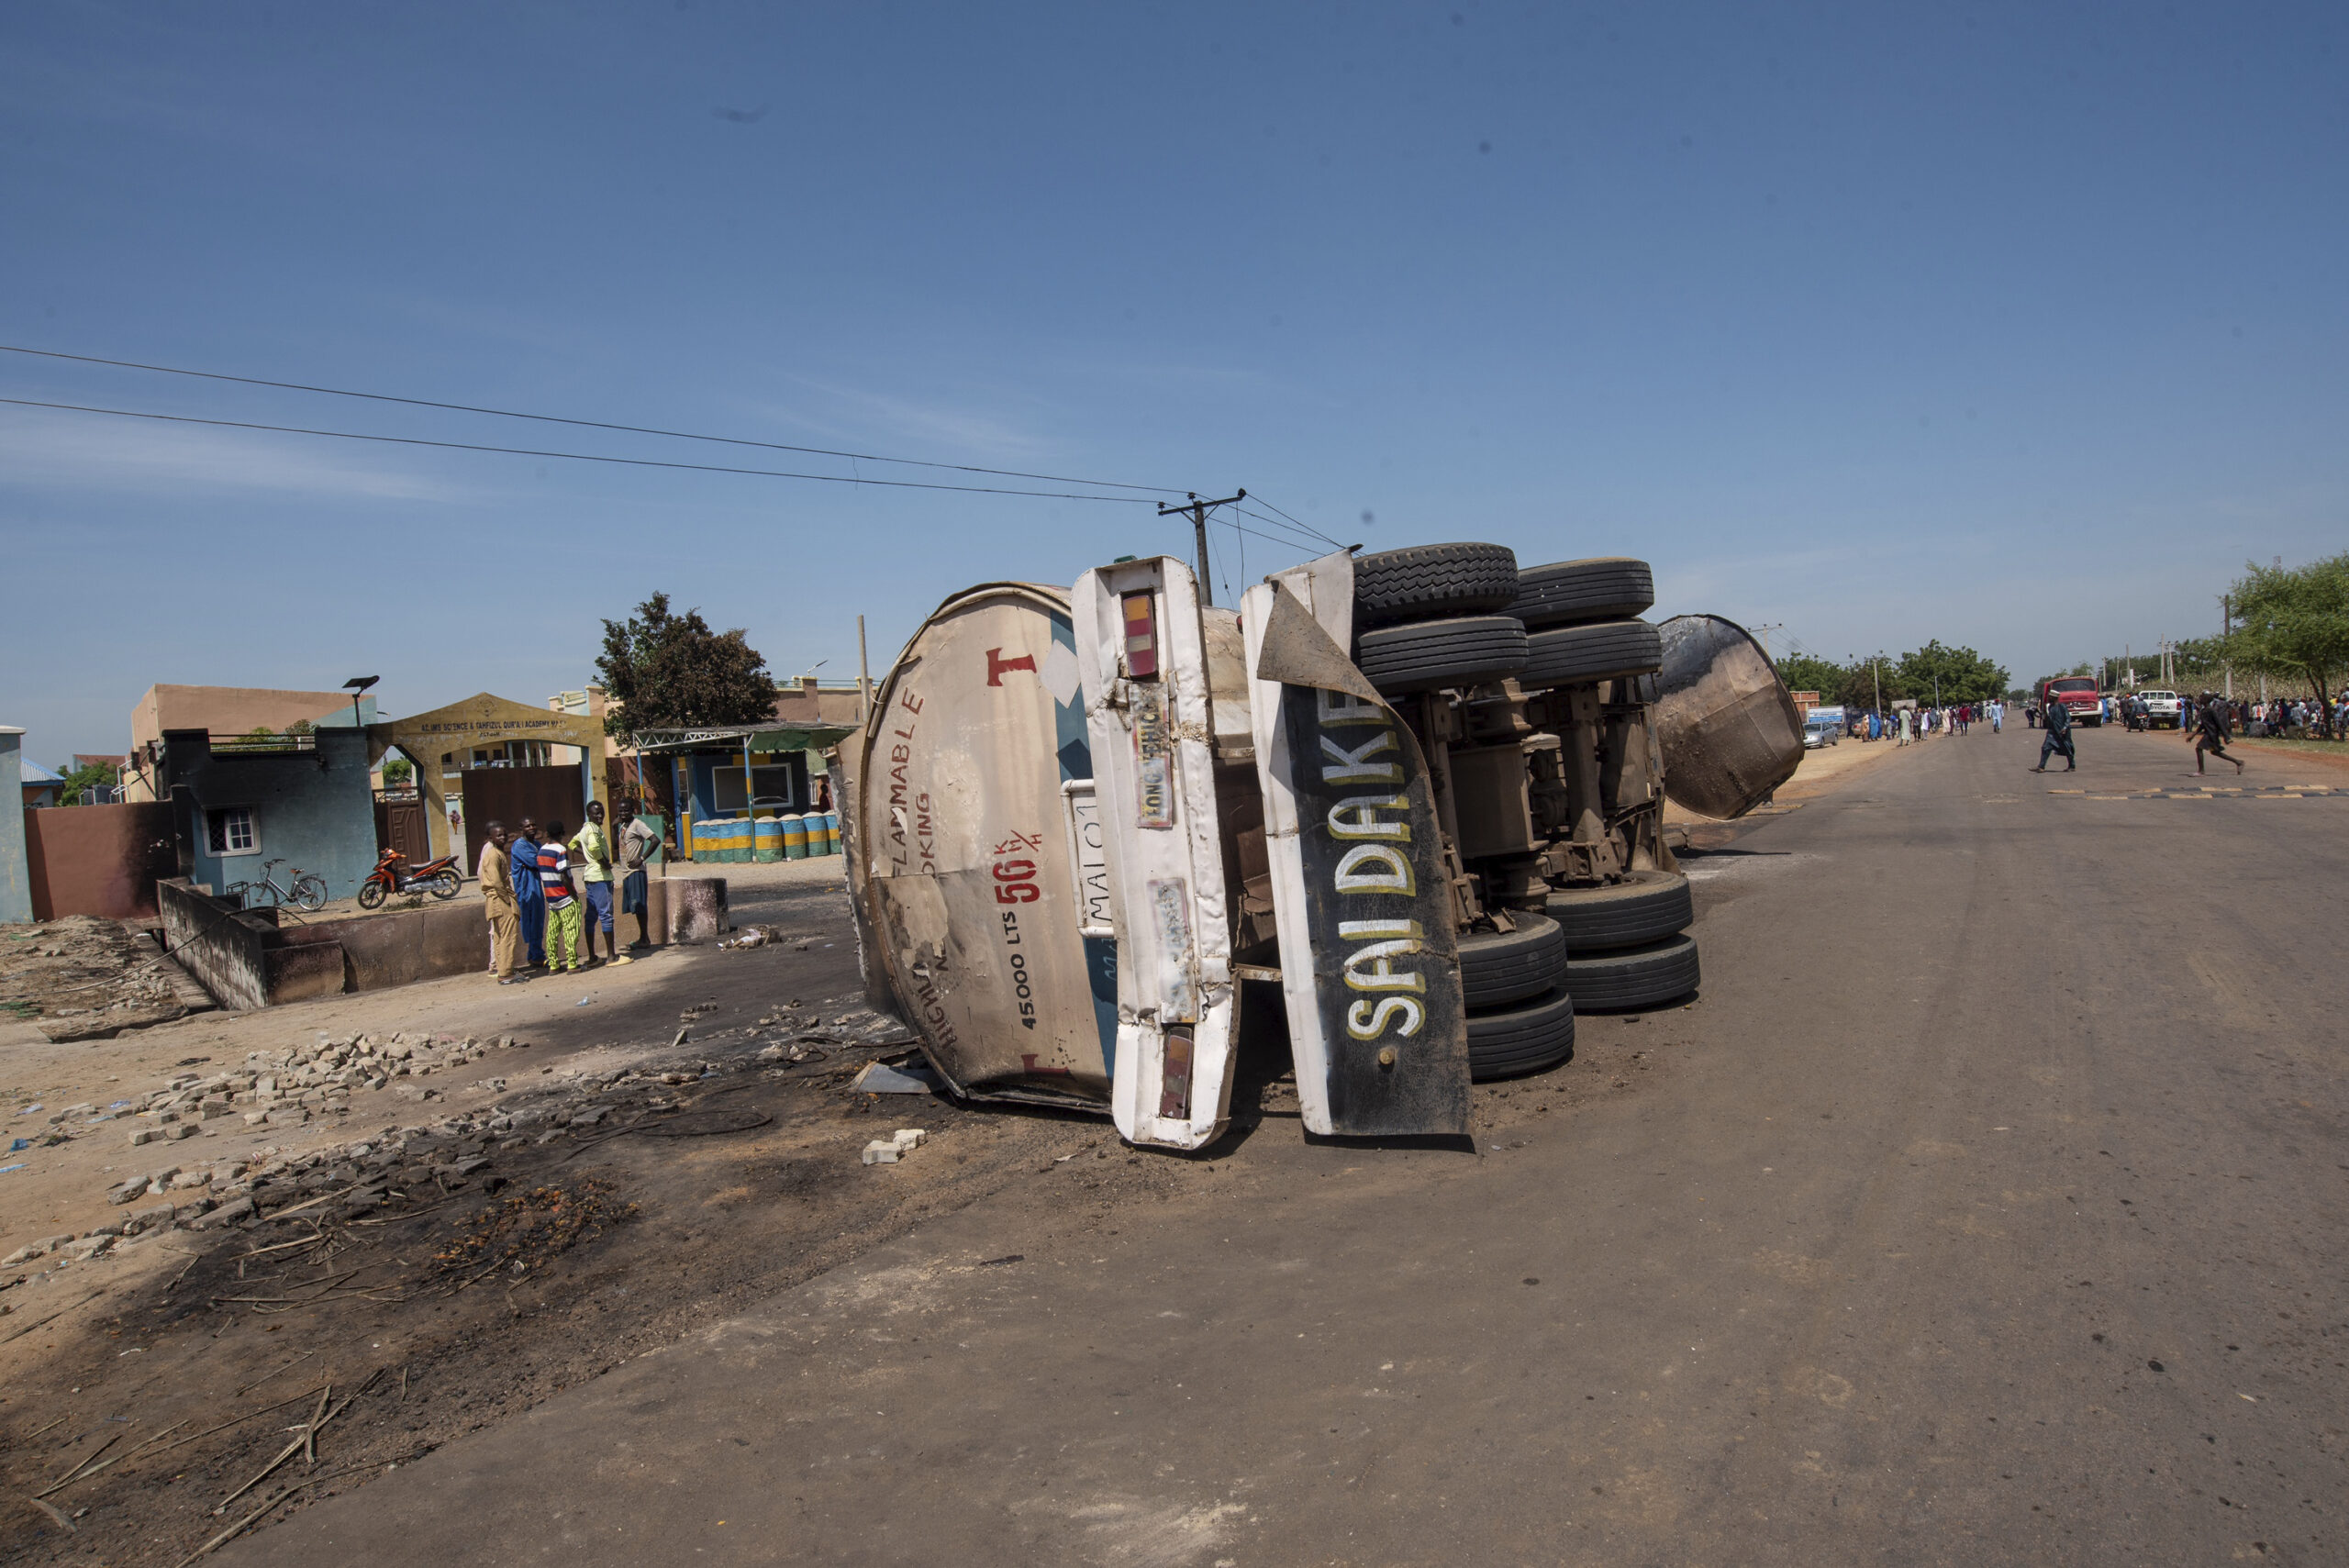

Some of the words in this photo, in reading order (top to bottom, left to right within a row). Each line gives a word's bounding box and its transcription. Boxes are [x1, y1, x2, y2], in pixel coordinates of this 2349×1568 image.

[443, 722, 468, 731] SCIENCE
[525, 719, 551, 728] ACADEMY
[993, 860, 1041, 904] 56
[1003, 911, 1020, 944] LTS
[1339, 919, 1426, 1040] SAI
